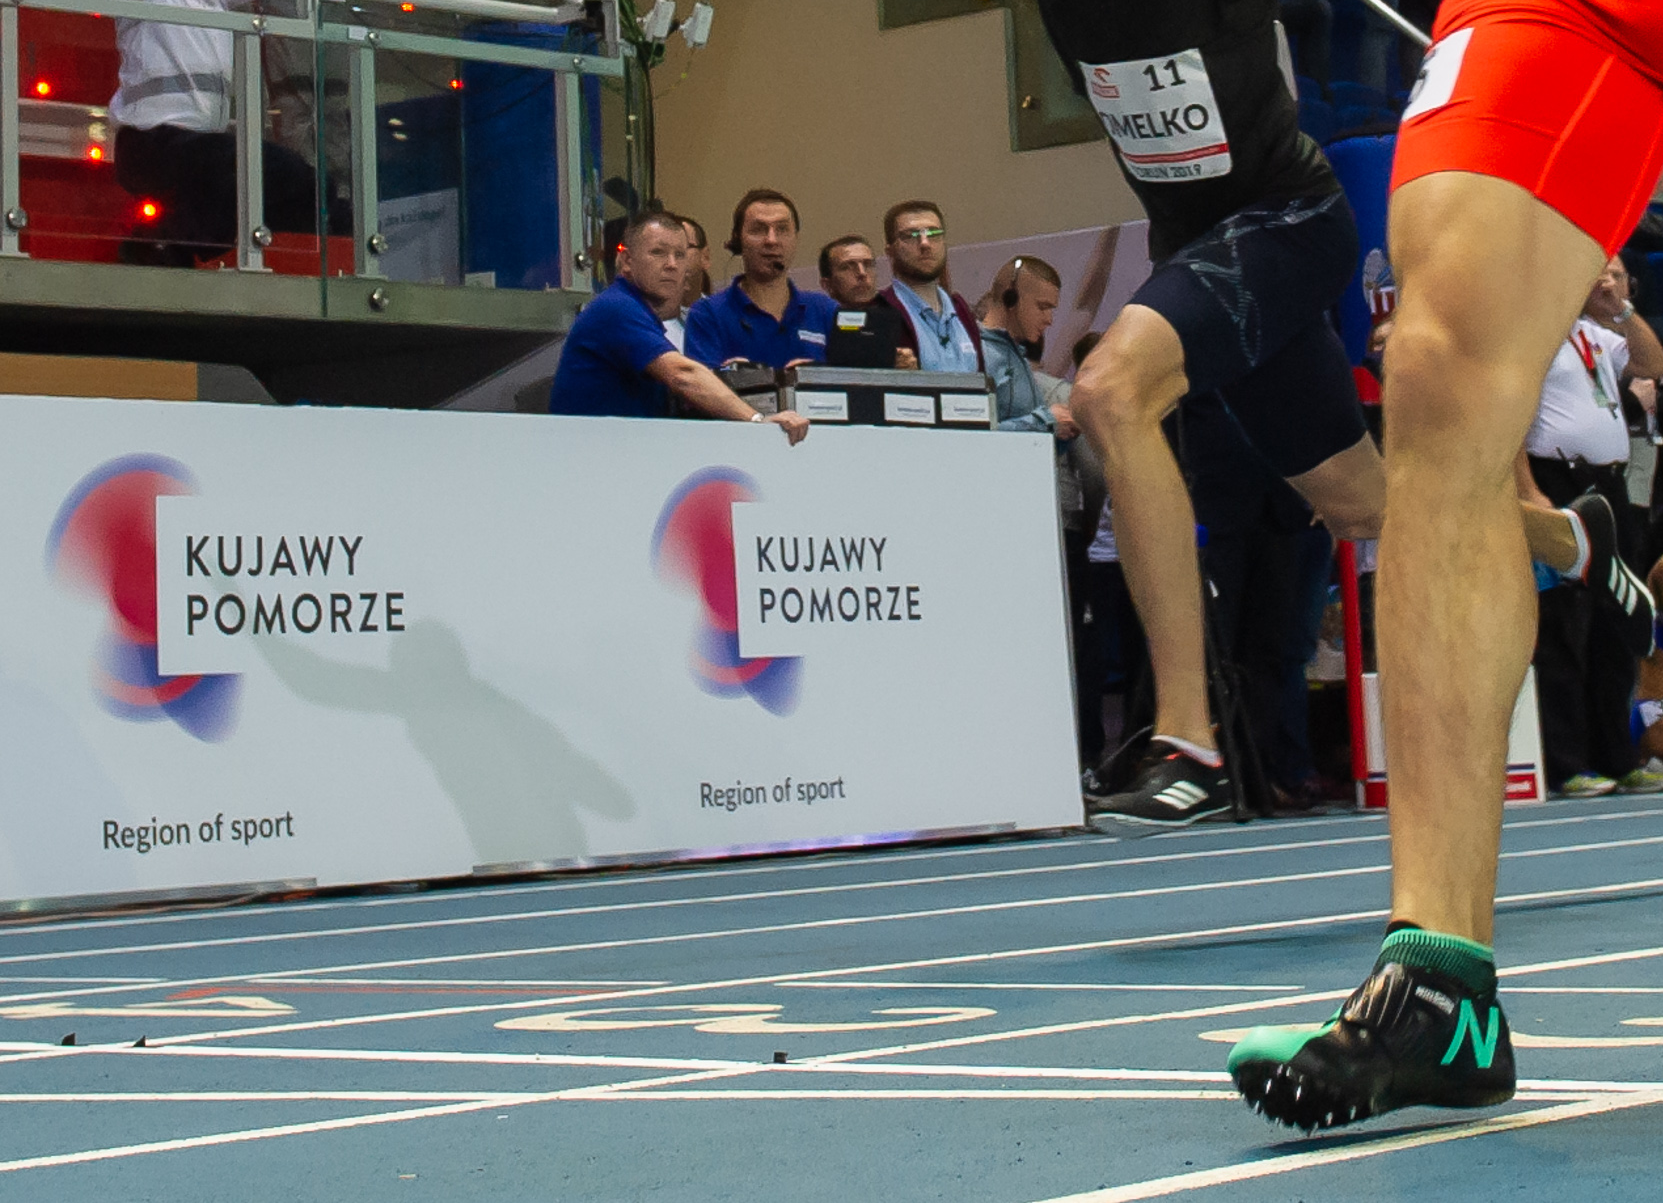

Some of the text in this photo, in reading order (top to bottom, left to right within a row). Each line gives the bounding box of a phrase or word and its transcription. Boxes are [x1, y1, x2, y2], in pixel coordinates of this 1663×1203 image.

[1143, 59, 1186, 91] 11
[186, 535, 364, 577] KUJAWY
[756, 536, 887, 573] KUJAWY
[186, 592, 406, 635] POMORZE
[759, 586, 922, 623] POMORZE
[700, 776, 845, 812] Region of sport
[103, 811, 295, 854] Region of sport
